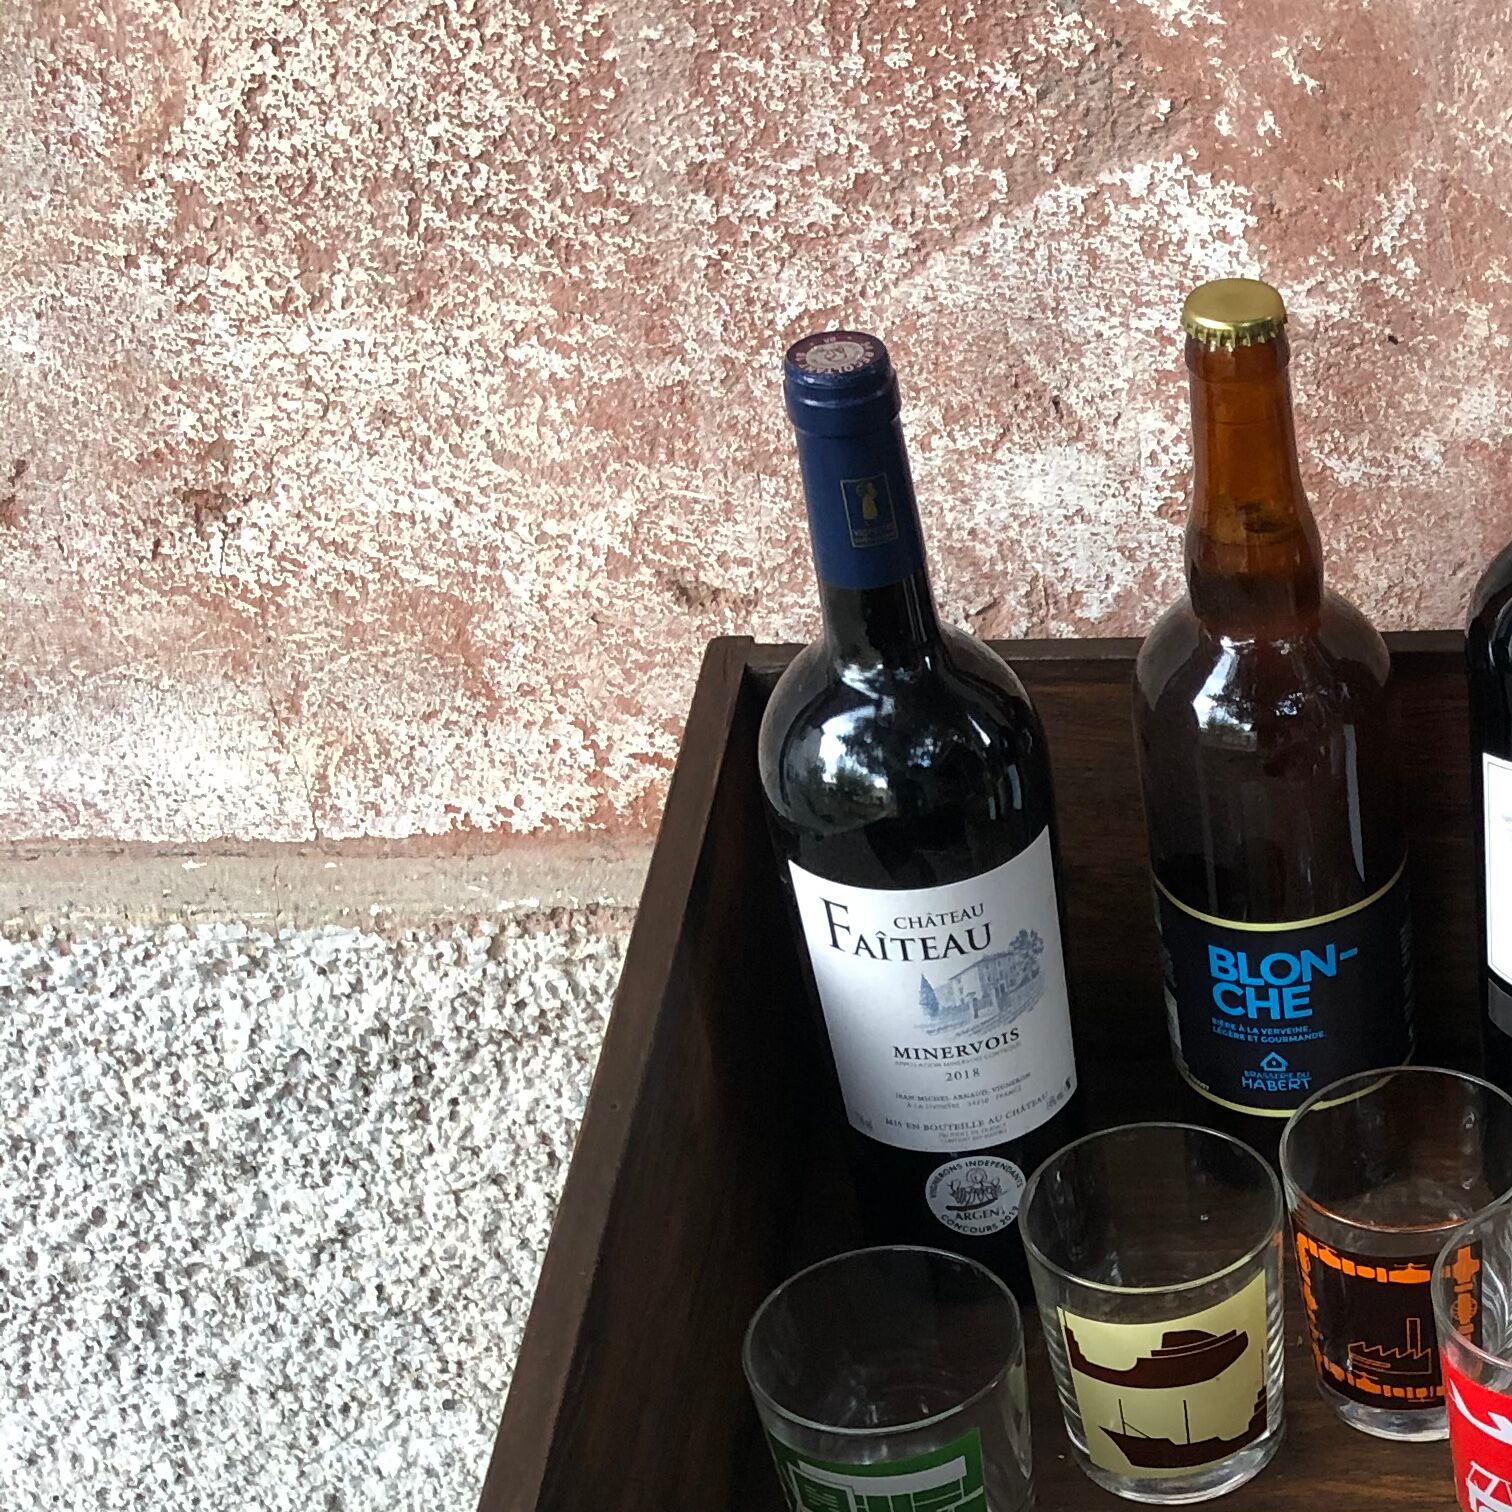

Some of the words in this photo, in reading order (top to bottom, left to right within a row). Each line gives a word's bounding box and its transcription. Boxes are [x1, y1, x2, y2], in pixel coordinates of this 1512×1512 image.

[893, 903, 985, 930] CHÂTEAU
[819, 897, 992, 962] FAÎTEAU
[1208, 943, 1358, 986] BLON-
[1212, 982, 1313, 1020] CHE
[893, 1028, 1020, 1060] MINERVOIS
[1248, 1035, 1258, 1043] ET
[945, 1067, 981, 1082] 2018
[1241, 1077, 1312, 1092] HABERT
[906, 1122, 921, 1130] EN
[924, 1120, 985, 1132] BOUTEILLE
[988, 1113, 1002, 1126] AU
[941, 1214, 998, 1234] CONCOURS
